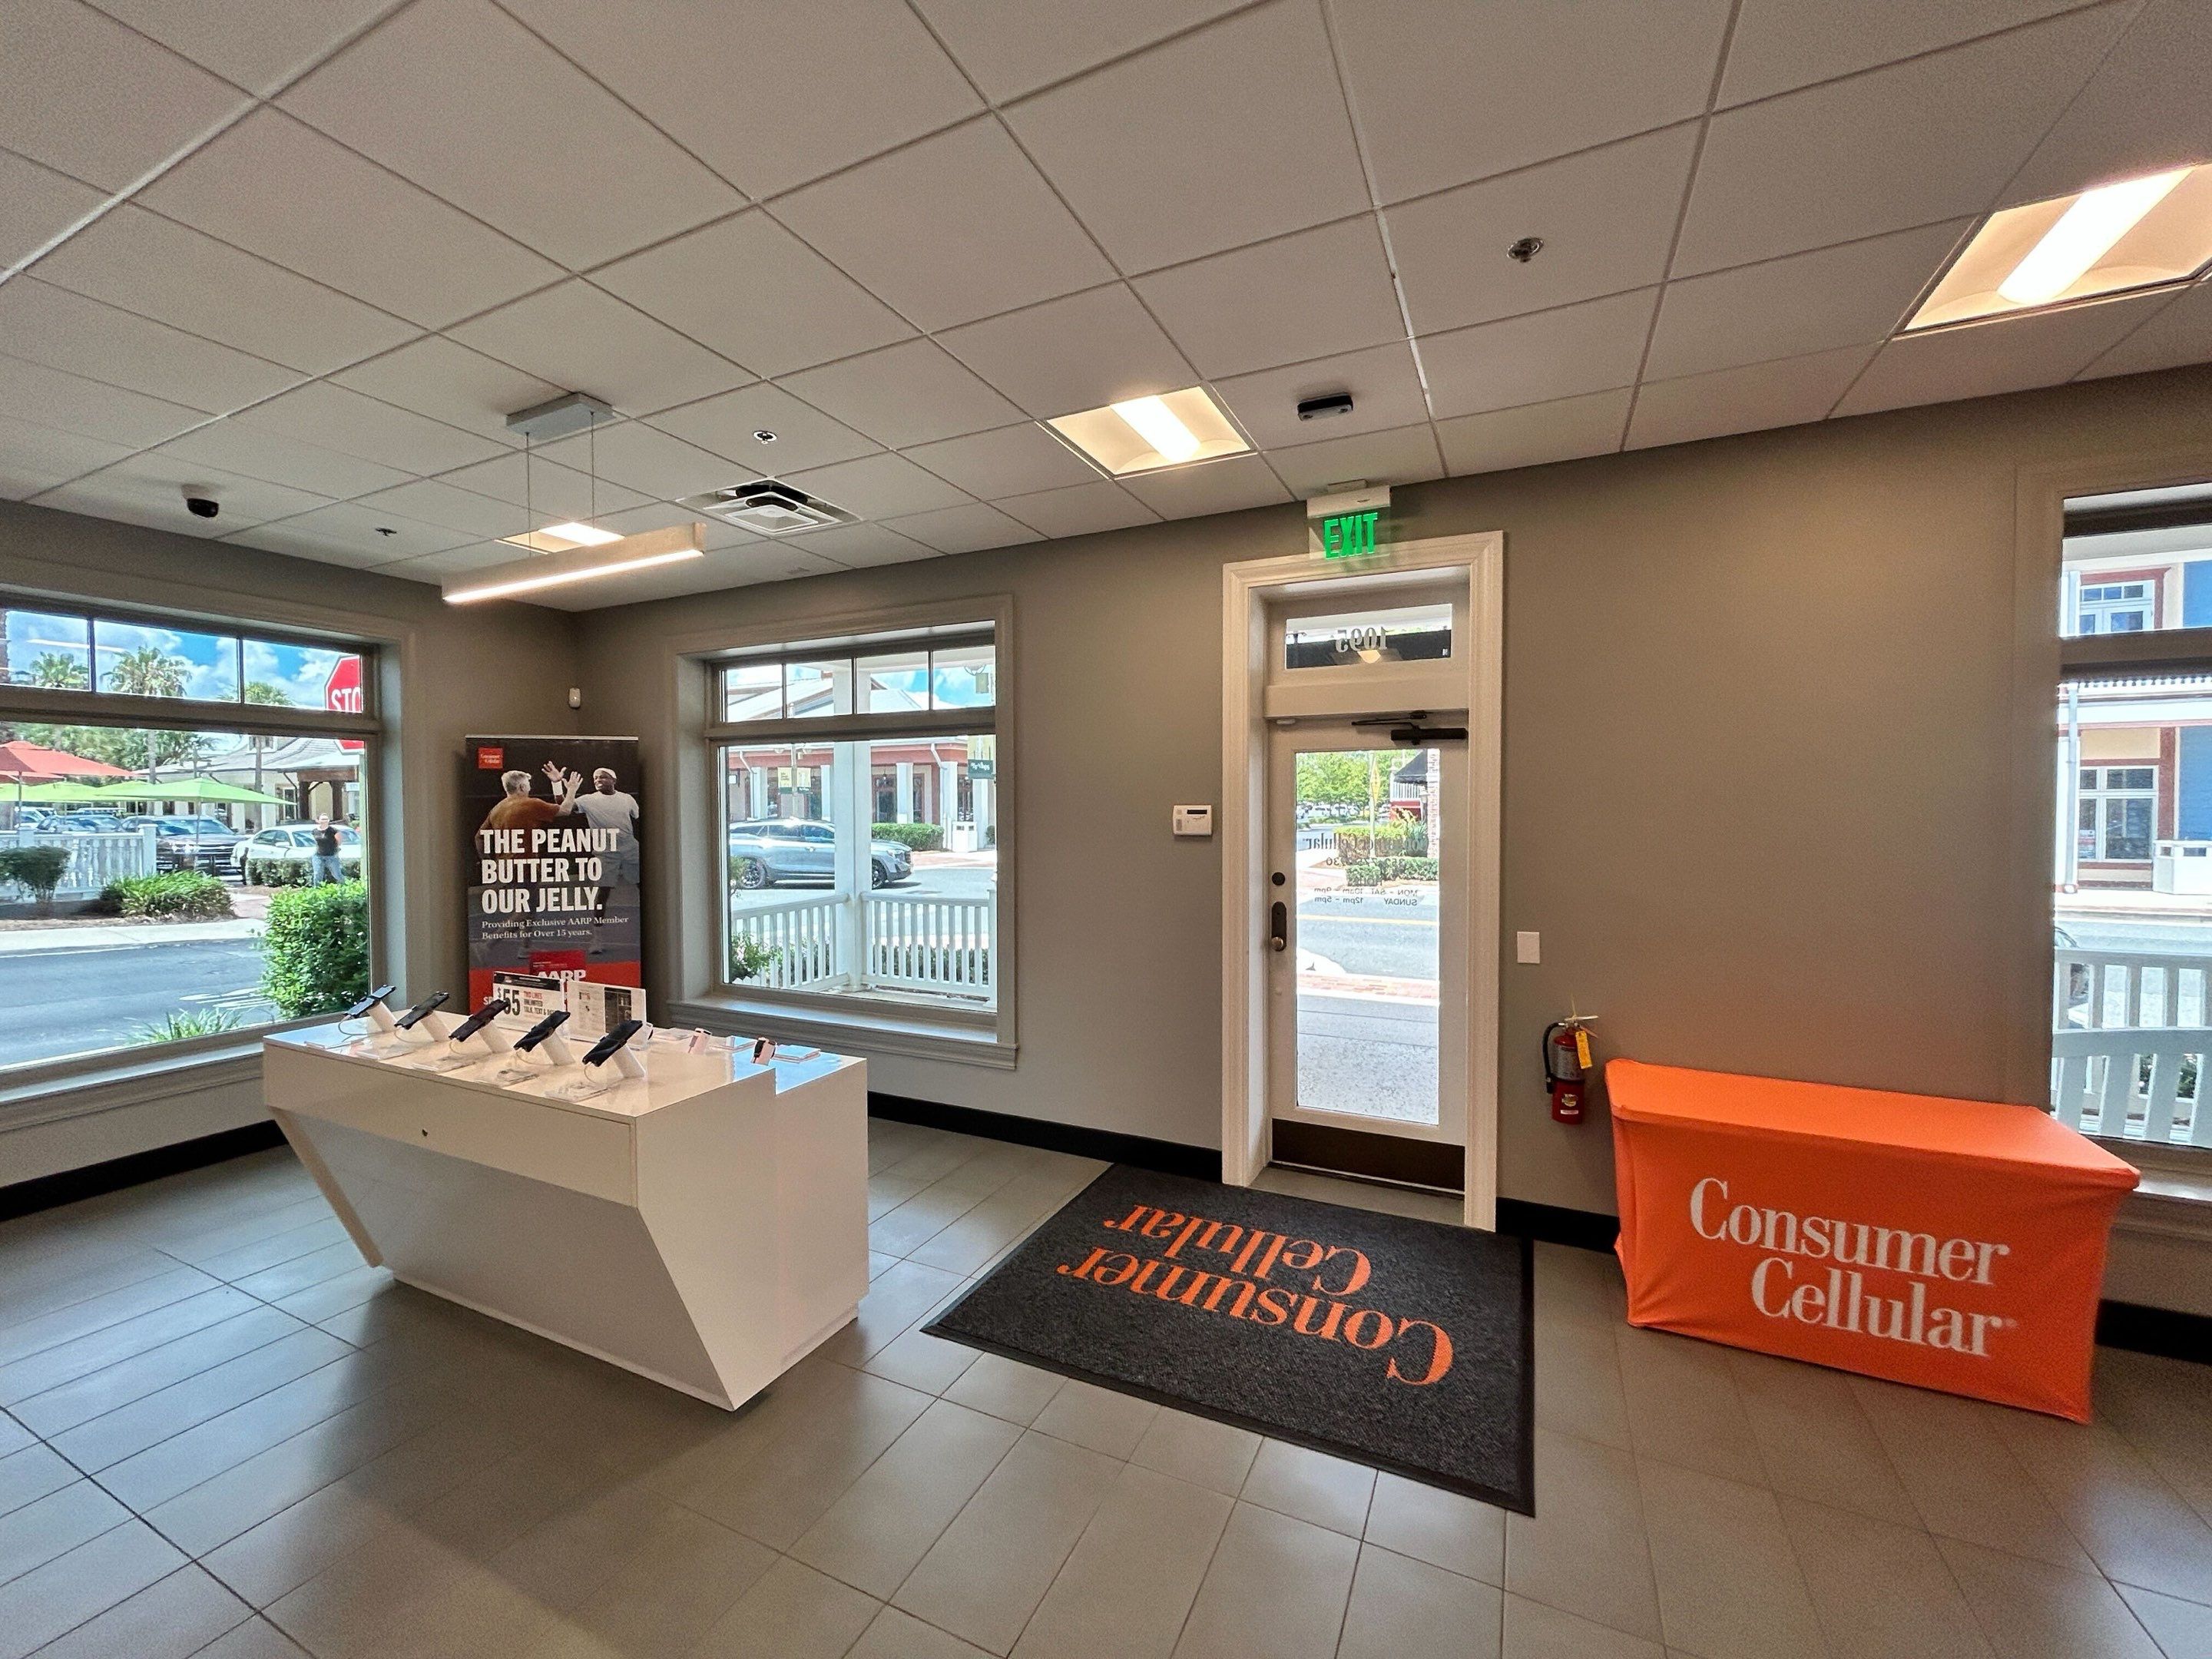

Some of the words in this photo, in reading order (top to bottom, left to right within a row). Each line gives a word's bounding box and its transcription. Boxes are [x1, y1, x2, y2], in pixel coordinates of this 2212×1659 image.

[1323, 512, 1378, 560] EXIT
[331, 686, 361, 713] STO
[480, 828, 525, 854] THE
[531, 828, 620, 853] PEANUT
[482, 858, 570, 884] BUTTER
[575, 857, 602, 882] TO
[482, 889, 530, 914] OUR
[536, 886, 603, 912] JELLY.
[482, 920, 525, 930] Providing
[526, 919, 566, 927] Exclusive
[568, 917, 591, 926] AARP
[594, 916, 629, 925] Member
[482, 930, 518, 940] Benefits
[519, 929, 531, 939] for
[533, 929, 555, 937] Over
[568, 929, 592, 939] years.
[1690, 1177, 2011, 1286] Consumer
[1104, 1204, 1372, 1296] Cellular
[1057, 1246, 1454, 1386] Consumer
[1751, 1257, 2004, 1357] Cellular
